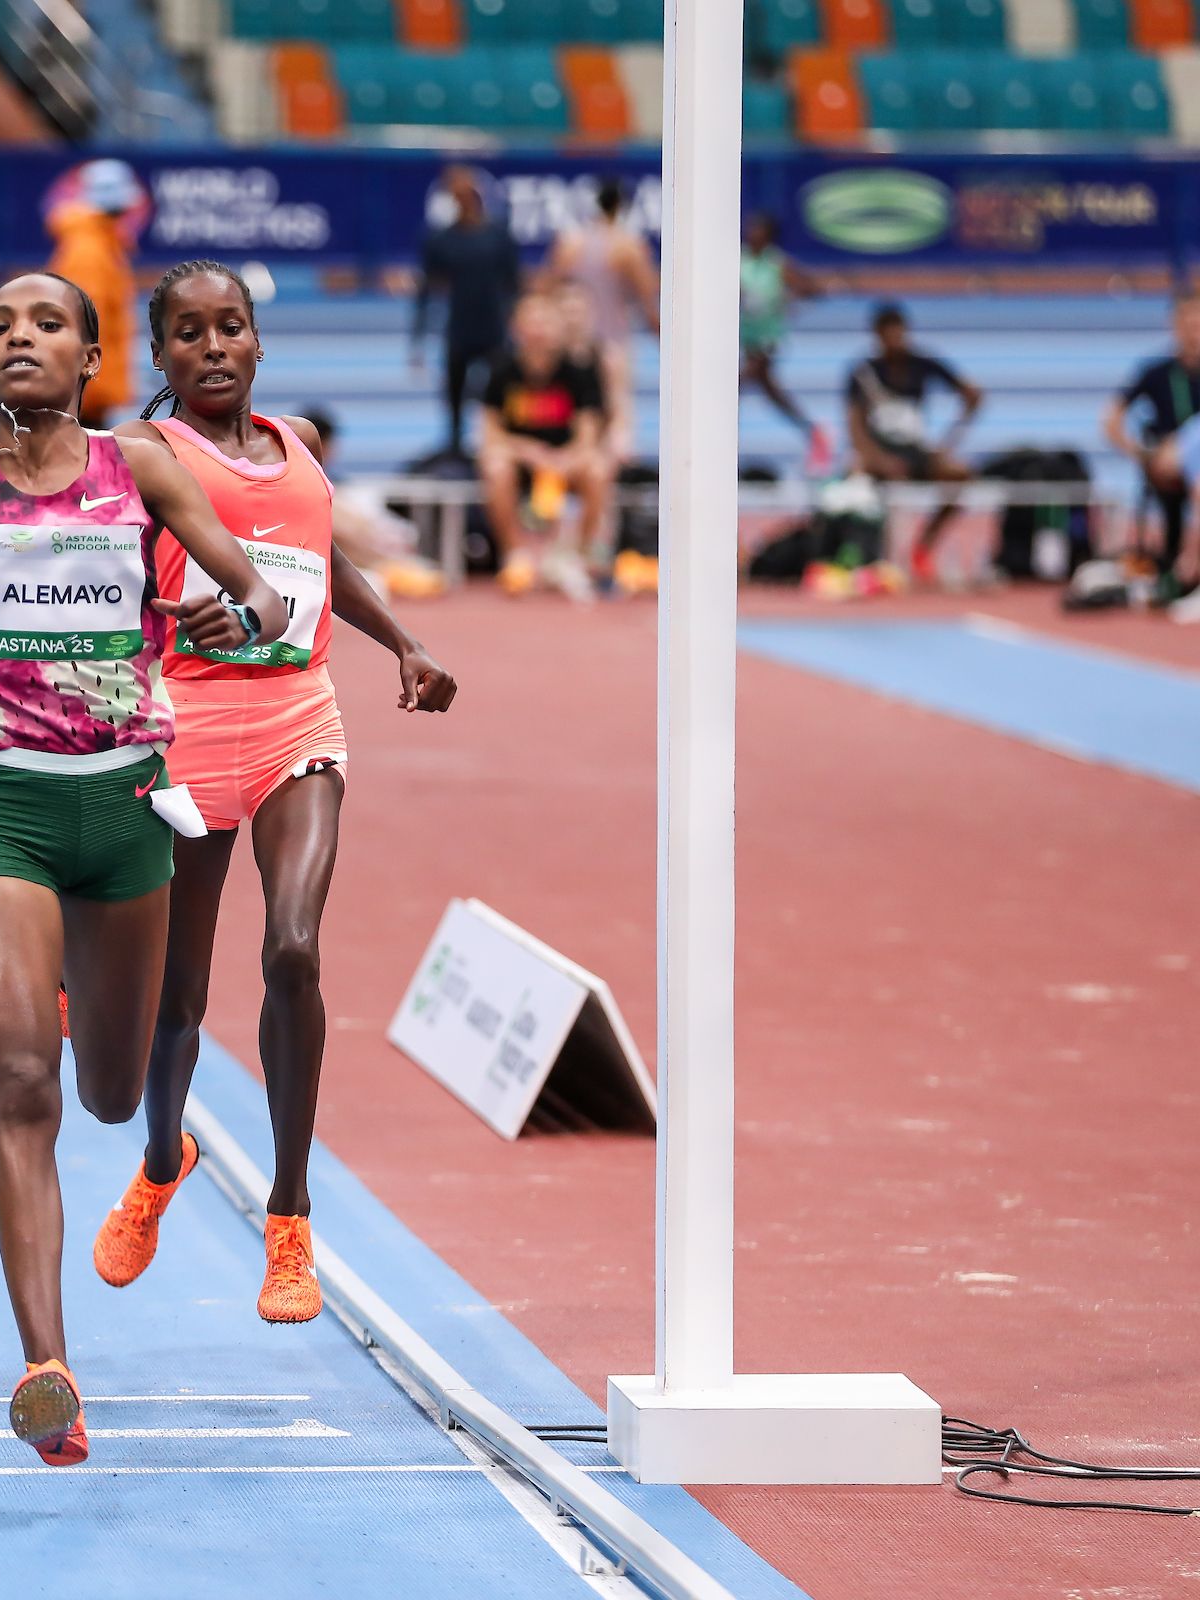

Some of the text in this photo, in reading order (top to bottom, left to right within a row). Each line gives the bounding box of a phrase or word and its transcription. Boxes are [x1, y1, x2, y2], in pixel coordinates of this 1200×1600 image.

[65, 535, 111, 543] ASTANA
[65, 543, 111, 551] INDOOR
[257, 550, 297, 563] ASTANA
[256, 557, 323, 577] INDOOR MEET
[2, 583, 123, 604] ALEMAYO
[251, 646, 272, 659] 25
